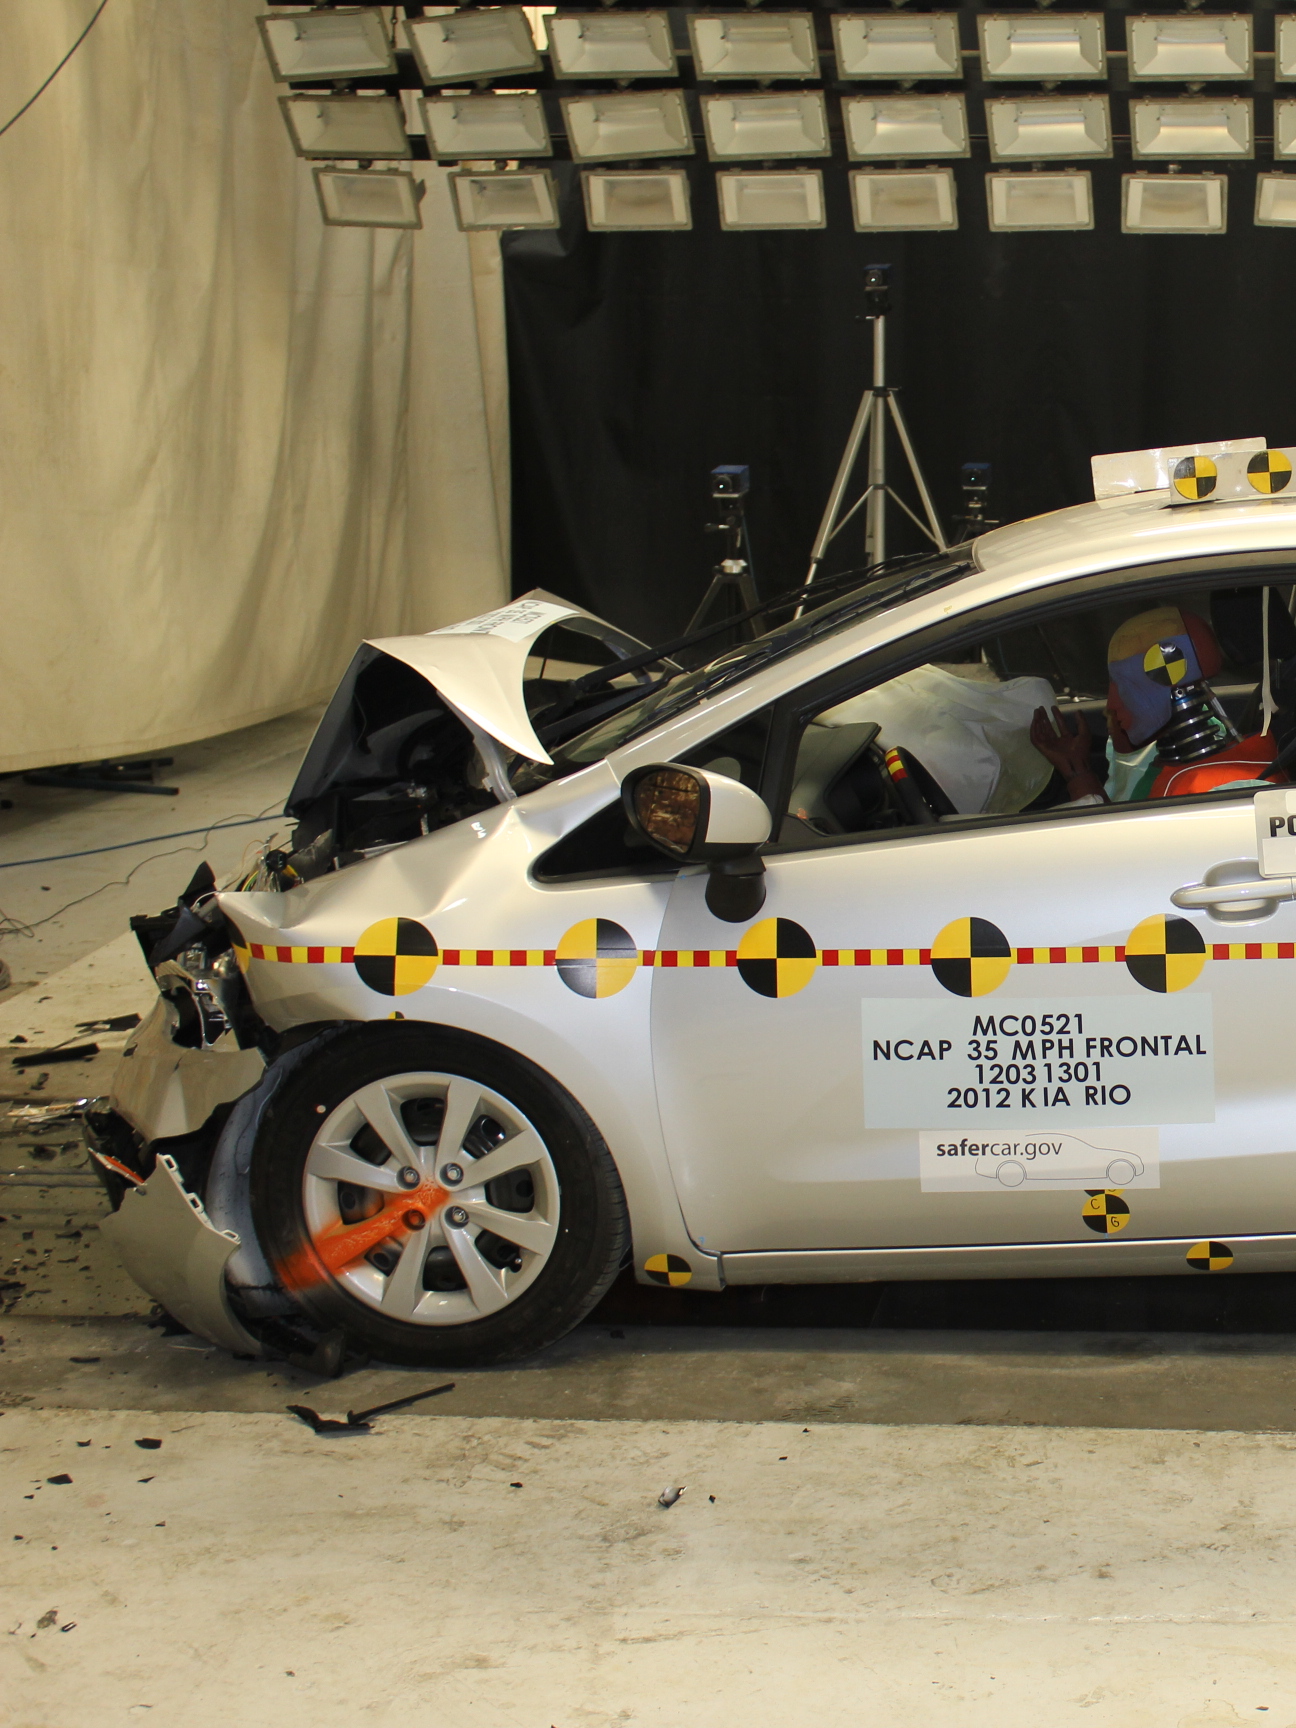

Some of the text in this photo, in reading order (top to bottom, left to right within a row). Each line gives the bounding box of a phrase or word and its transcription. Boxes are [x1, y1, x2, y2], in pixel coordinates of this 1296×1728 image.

[972, 1013, 1084, 1038] MC0521
[873, 1034, 1207, 1061] NCAP 35 MPH FRONTAL
[974, 1061, 1101, 1085] 12031301
[946, 1084, 1132, 1109] 2012 KIA RIO
[936, 1138, 1063, 1161] safercar.gov
[1090, 1198, 1101, 1210] C
